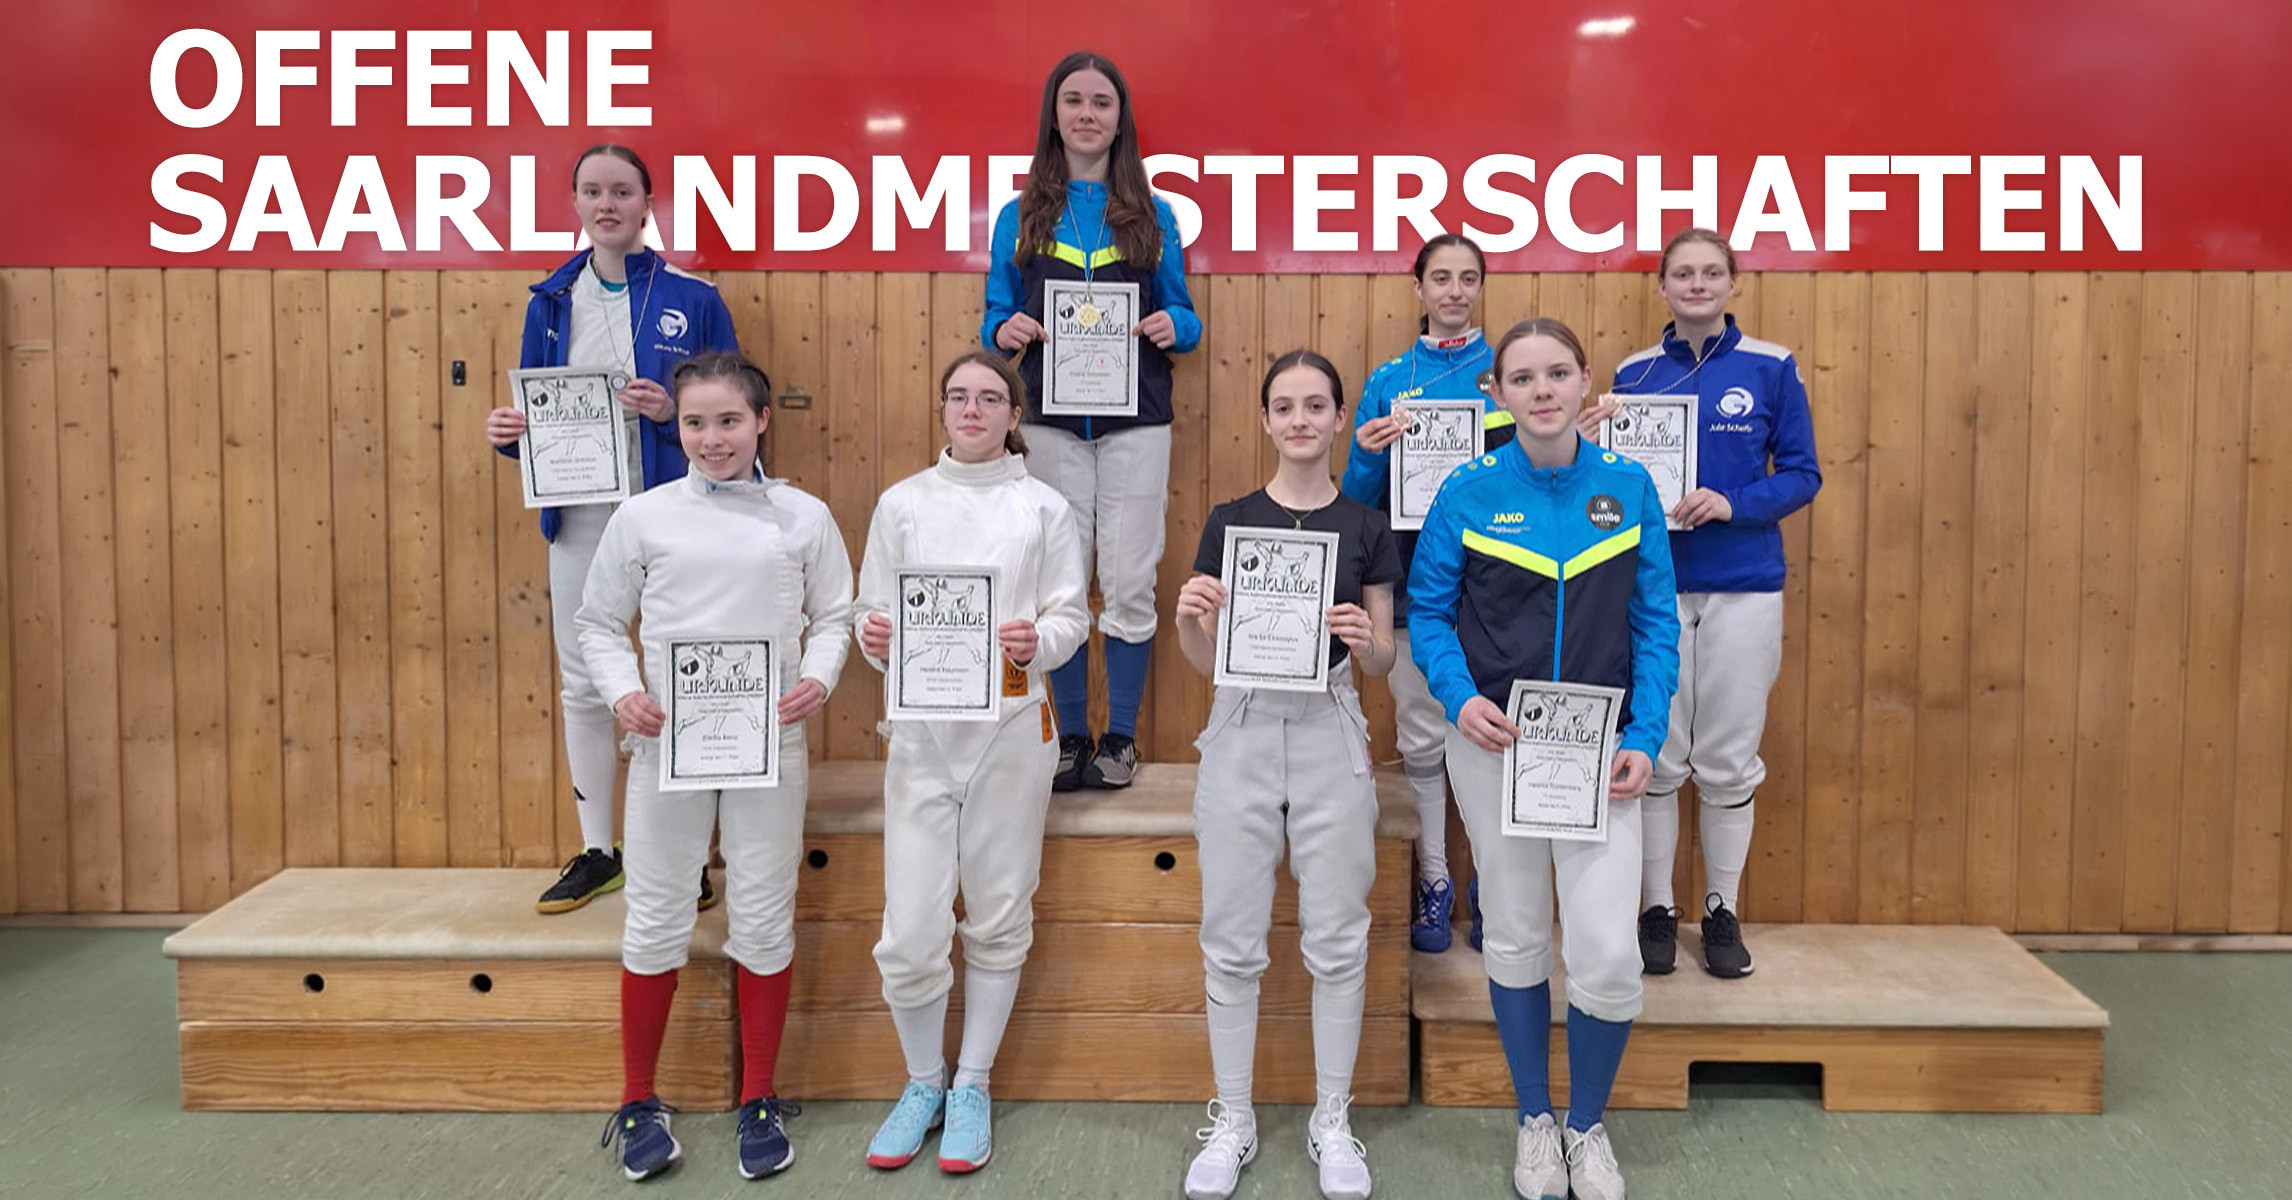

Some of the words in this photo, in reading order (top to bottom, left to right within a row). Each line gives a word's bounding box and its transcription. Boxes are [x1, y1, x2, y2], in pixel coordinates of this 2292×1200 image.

[1493, 512, 1525, 524] JAKO
[1590, 511, 1621, 523] smile
[681, 677, 765, 694] URKUNDE
